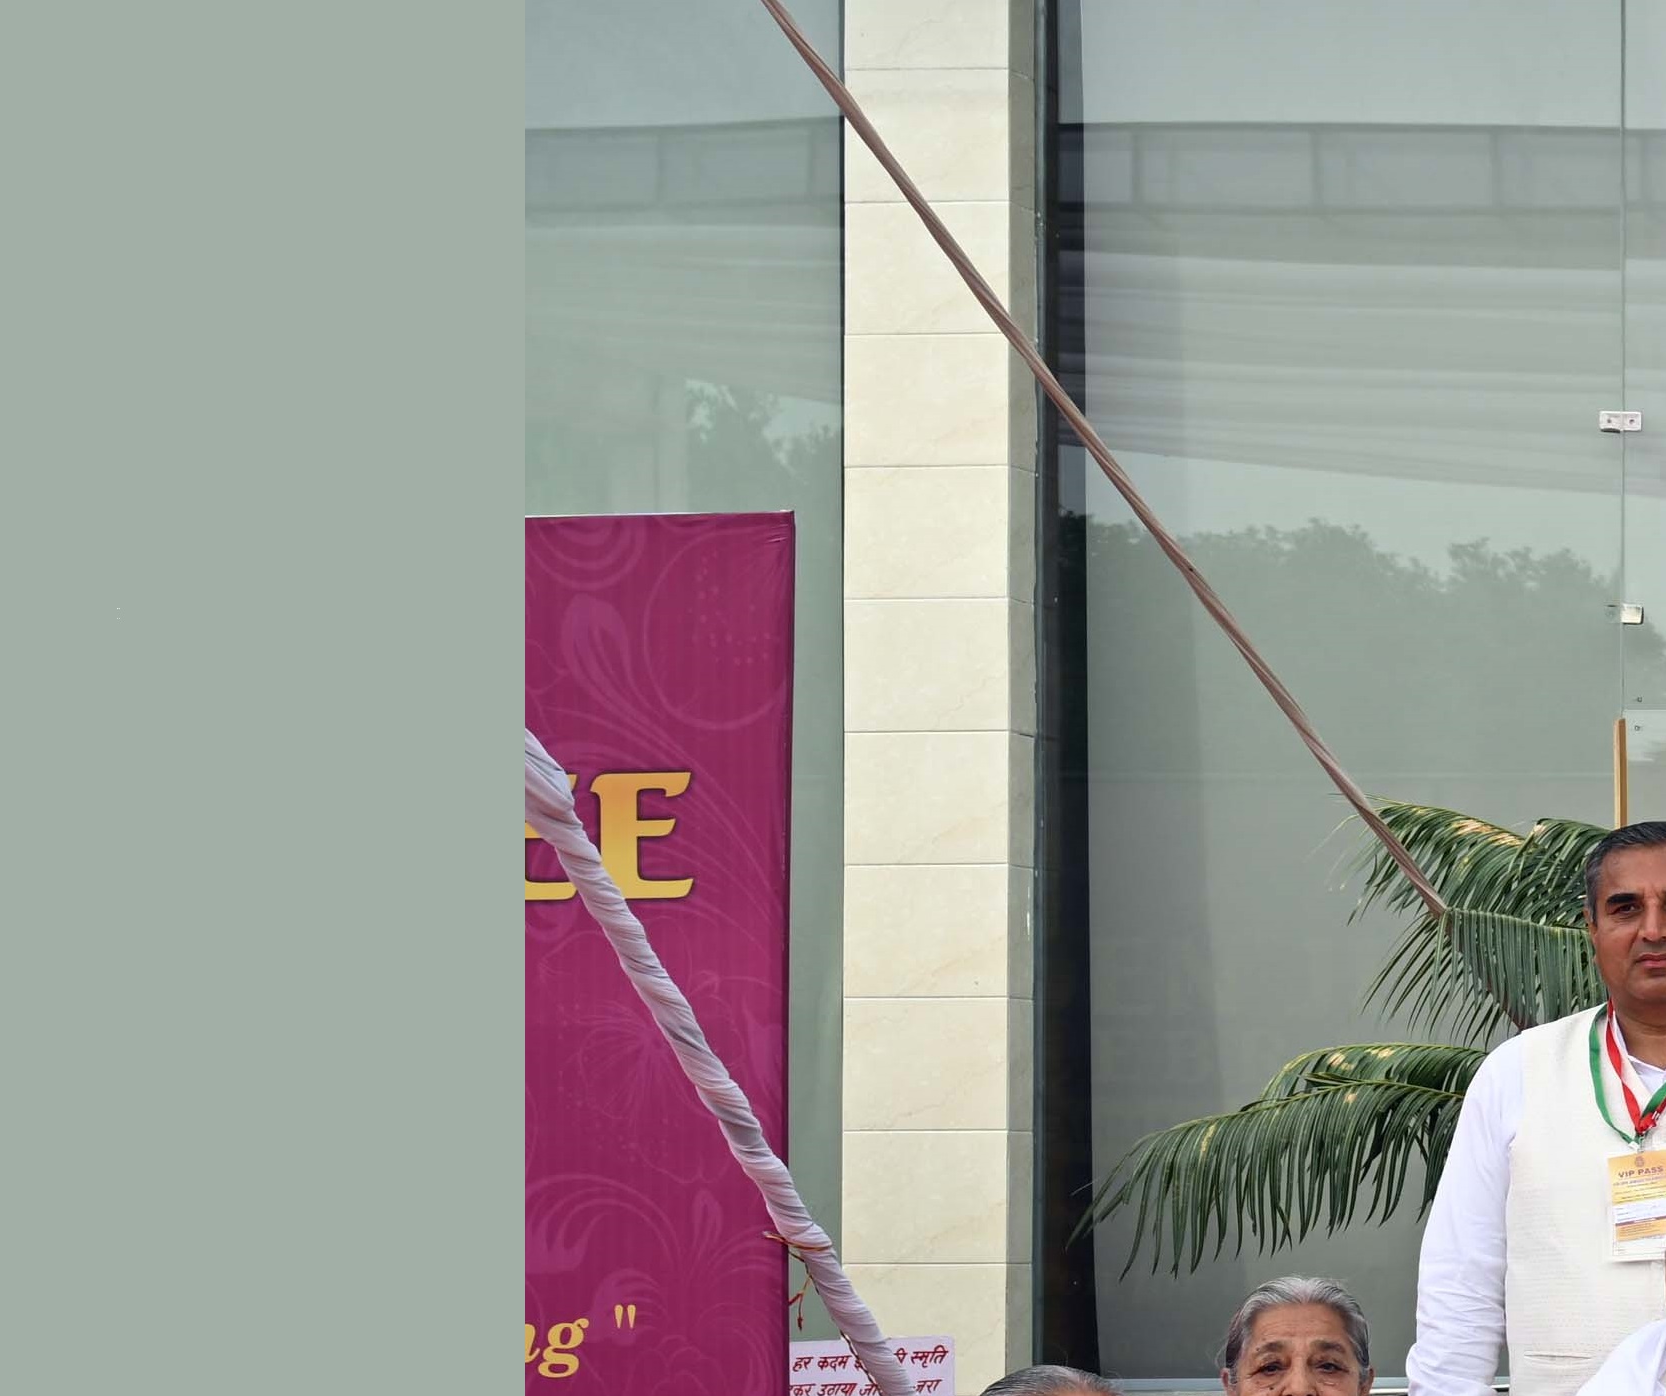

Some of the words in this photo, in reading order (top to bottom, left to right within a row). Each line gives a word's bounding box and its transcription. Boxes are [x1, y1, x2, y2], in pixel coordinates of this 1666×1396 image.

[1618, 1169, 1635, 1178] VIP
[1637, 1165, 1664, 1176] PASS
[792, 1355, 814, 1372] हर
[817, 1354, 852, 1372] कदम
[910, 1344, 949, 1368] स्मृति
